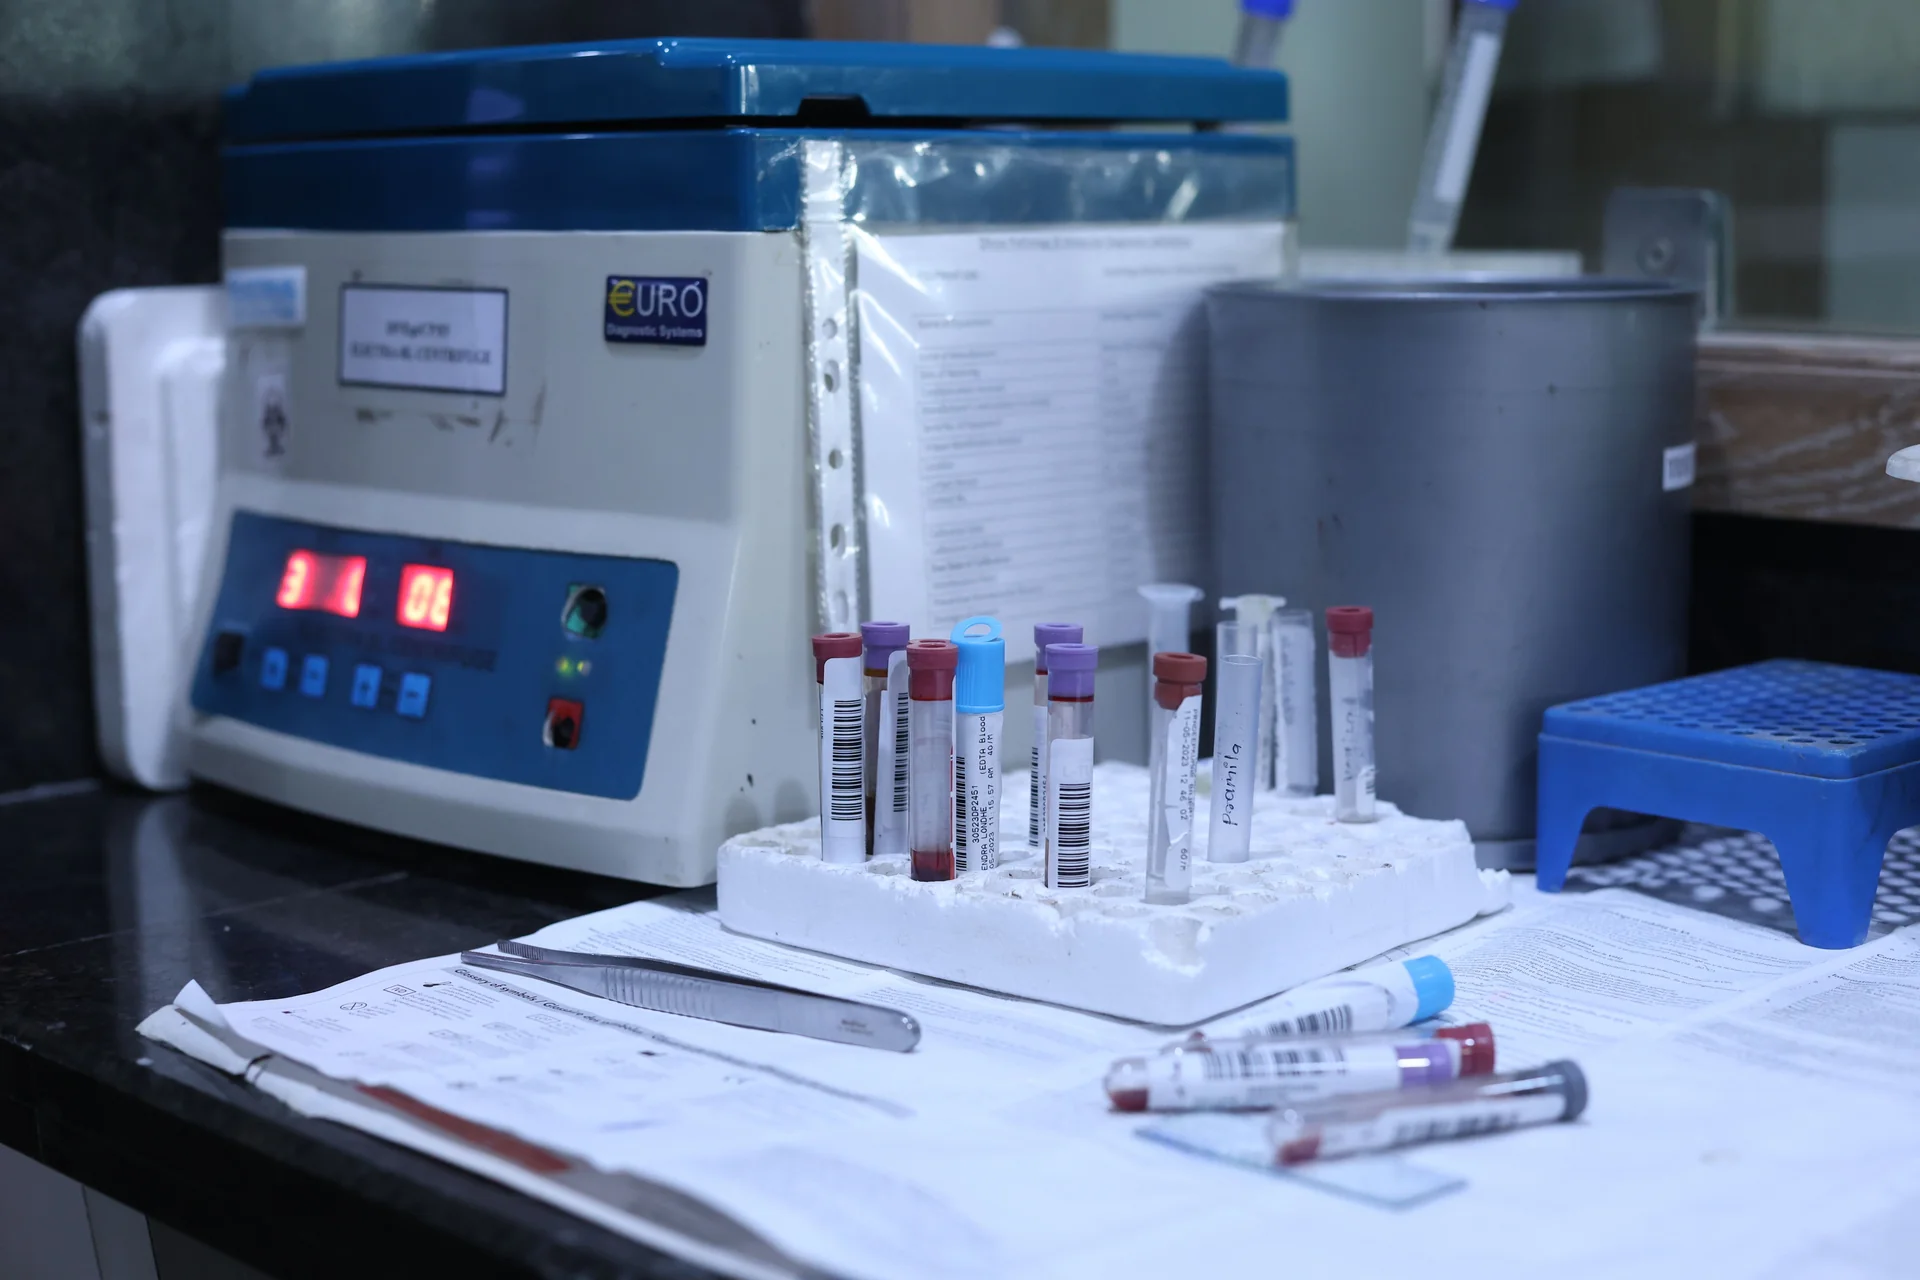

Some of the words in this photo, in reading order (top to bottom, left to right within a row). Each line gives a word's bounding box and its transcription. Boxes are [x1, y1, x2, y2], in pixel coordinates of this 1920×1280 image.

[607, 323, 656, 339] Diagnostic
[659, 325, 702, 339] Systems
[978, 715, 987, 744] Blood
[1180, 709, 1190, 767] 11-05-2023
[978, 748, 987, 775] (EDTA
[986, 766, 994, 778] AM
[971, 785, 980, 844] 30523DP2451
[979, 806, 988, 839] LONDHE
[454, 967, 489, 985] Glossary
[489, 980, 503, 990] of
[500, 986, 537, 1003] symbols
